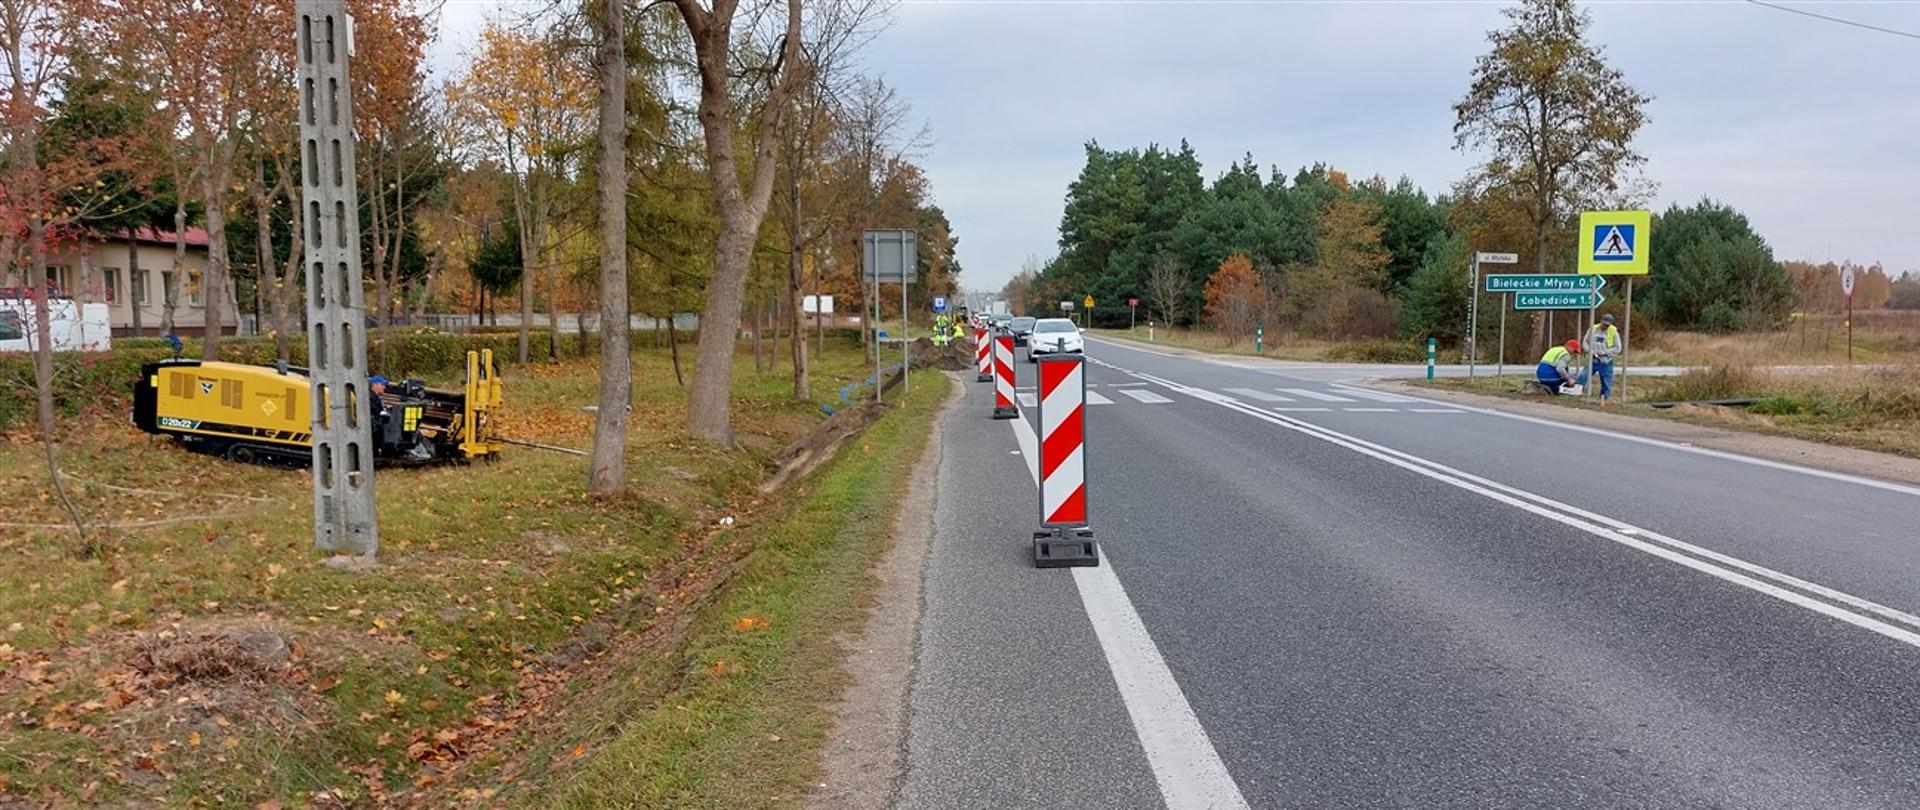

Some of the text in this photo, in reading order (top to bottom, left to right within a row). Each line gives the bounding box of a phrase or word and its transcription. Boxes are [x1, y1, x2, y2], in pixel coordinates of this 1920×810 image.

[1493, 278, 1540, 288] Bieleckie
[1544, 278, 1576, 290] Młyny
[1521, 295, 1577, 306] Łabędziów
